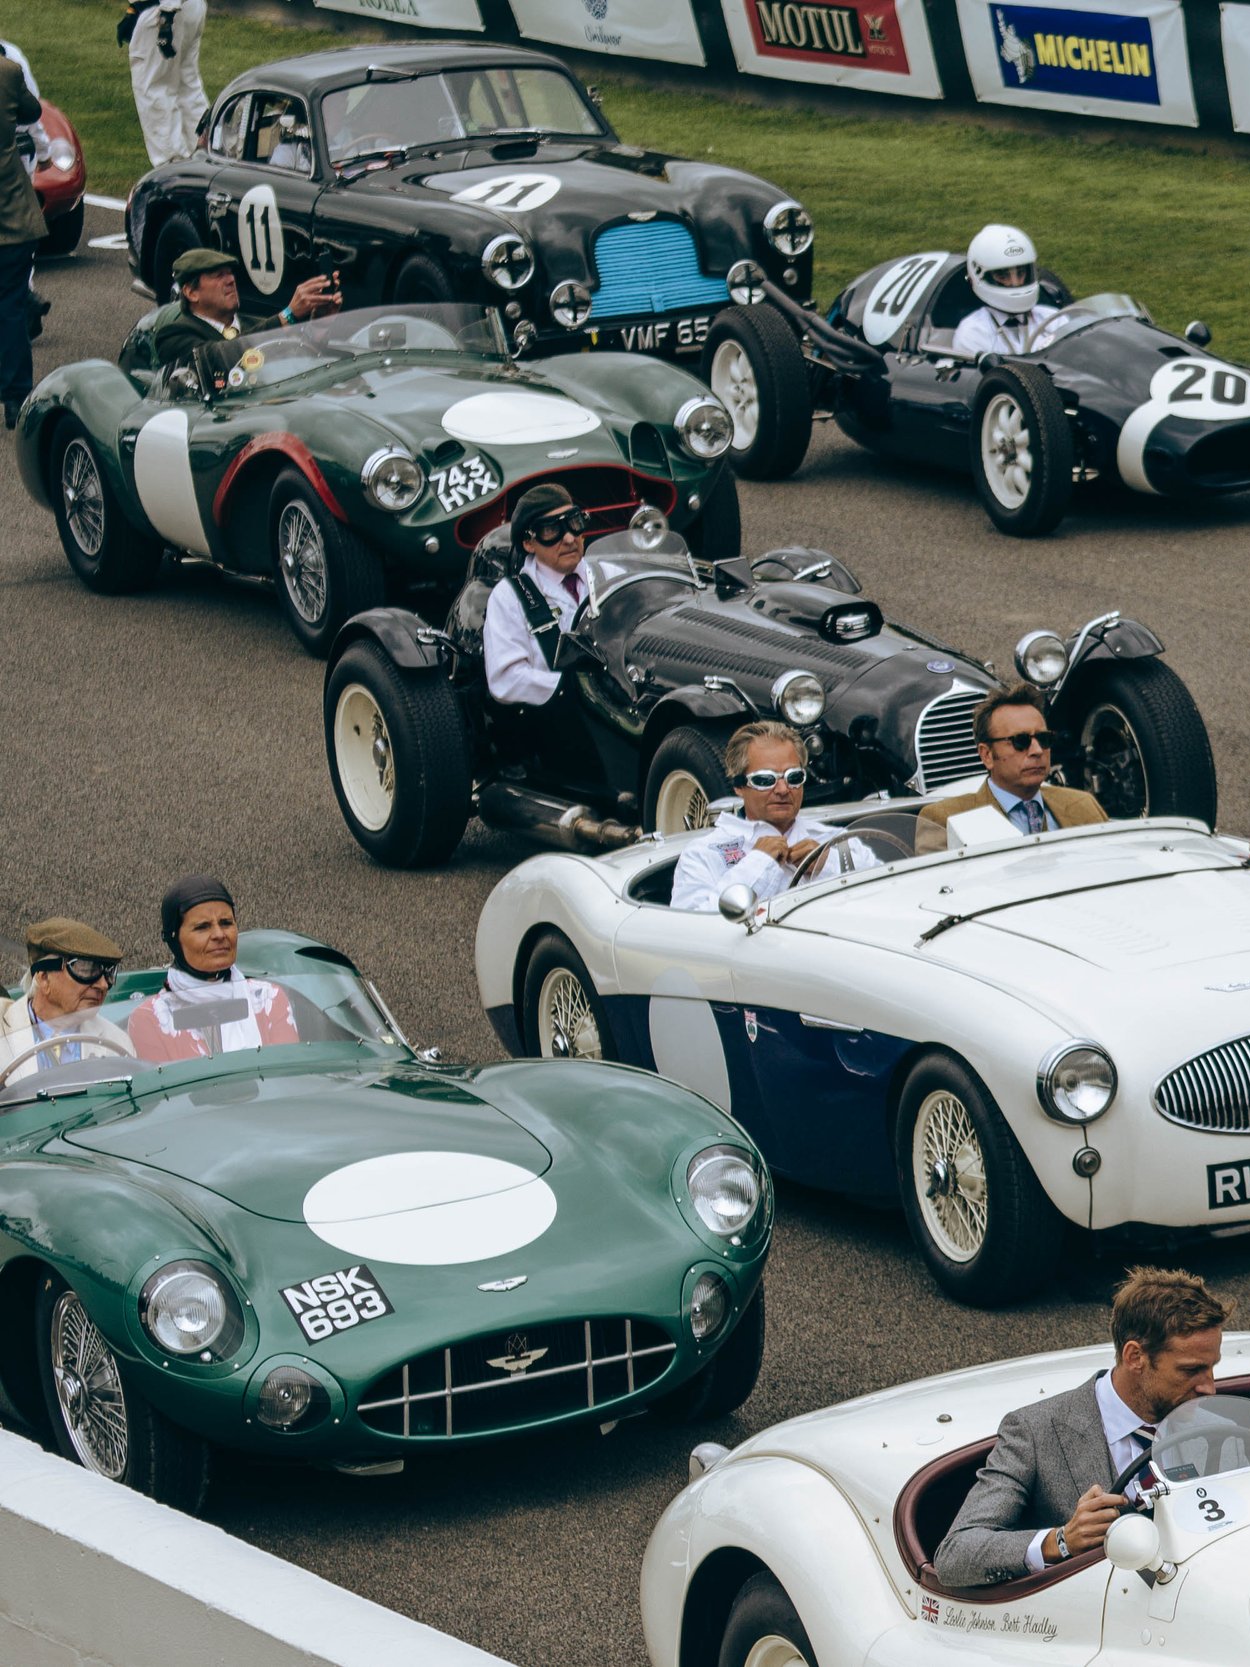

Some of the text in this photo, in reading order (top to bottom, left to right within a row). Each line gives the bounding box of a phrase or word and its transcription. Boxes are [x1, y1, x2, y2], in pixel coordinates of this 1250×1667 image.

[756, 2, 864, 54] MOTUL
[1034, 33, 1151, 77] MICHELIN
[470, 181, 546, 208] 11
[246, 203, 275, 273] 11
[871, 257, 938, 317] 20
[621, 317, 709, 351] VMF 65
[1168, 363, 1247, 407] 20
[428, 455, 486, 495] 743
[438, 471, 498, 513] HYX
[283, 1266, 375, 1315] NSK
[300, 1289, 387, 1340] 693
[1198, 1499, 1225, 1522] 3
[943, 1606, 1059, 1643] Leslie Johnson Bert Hadley
